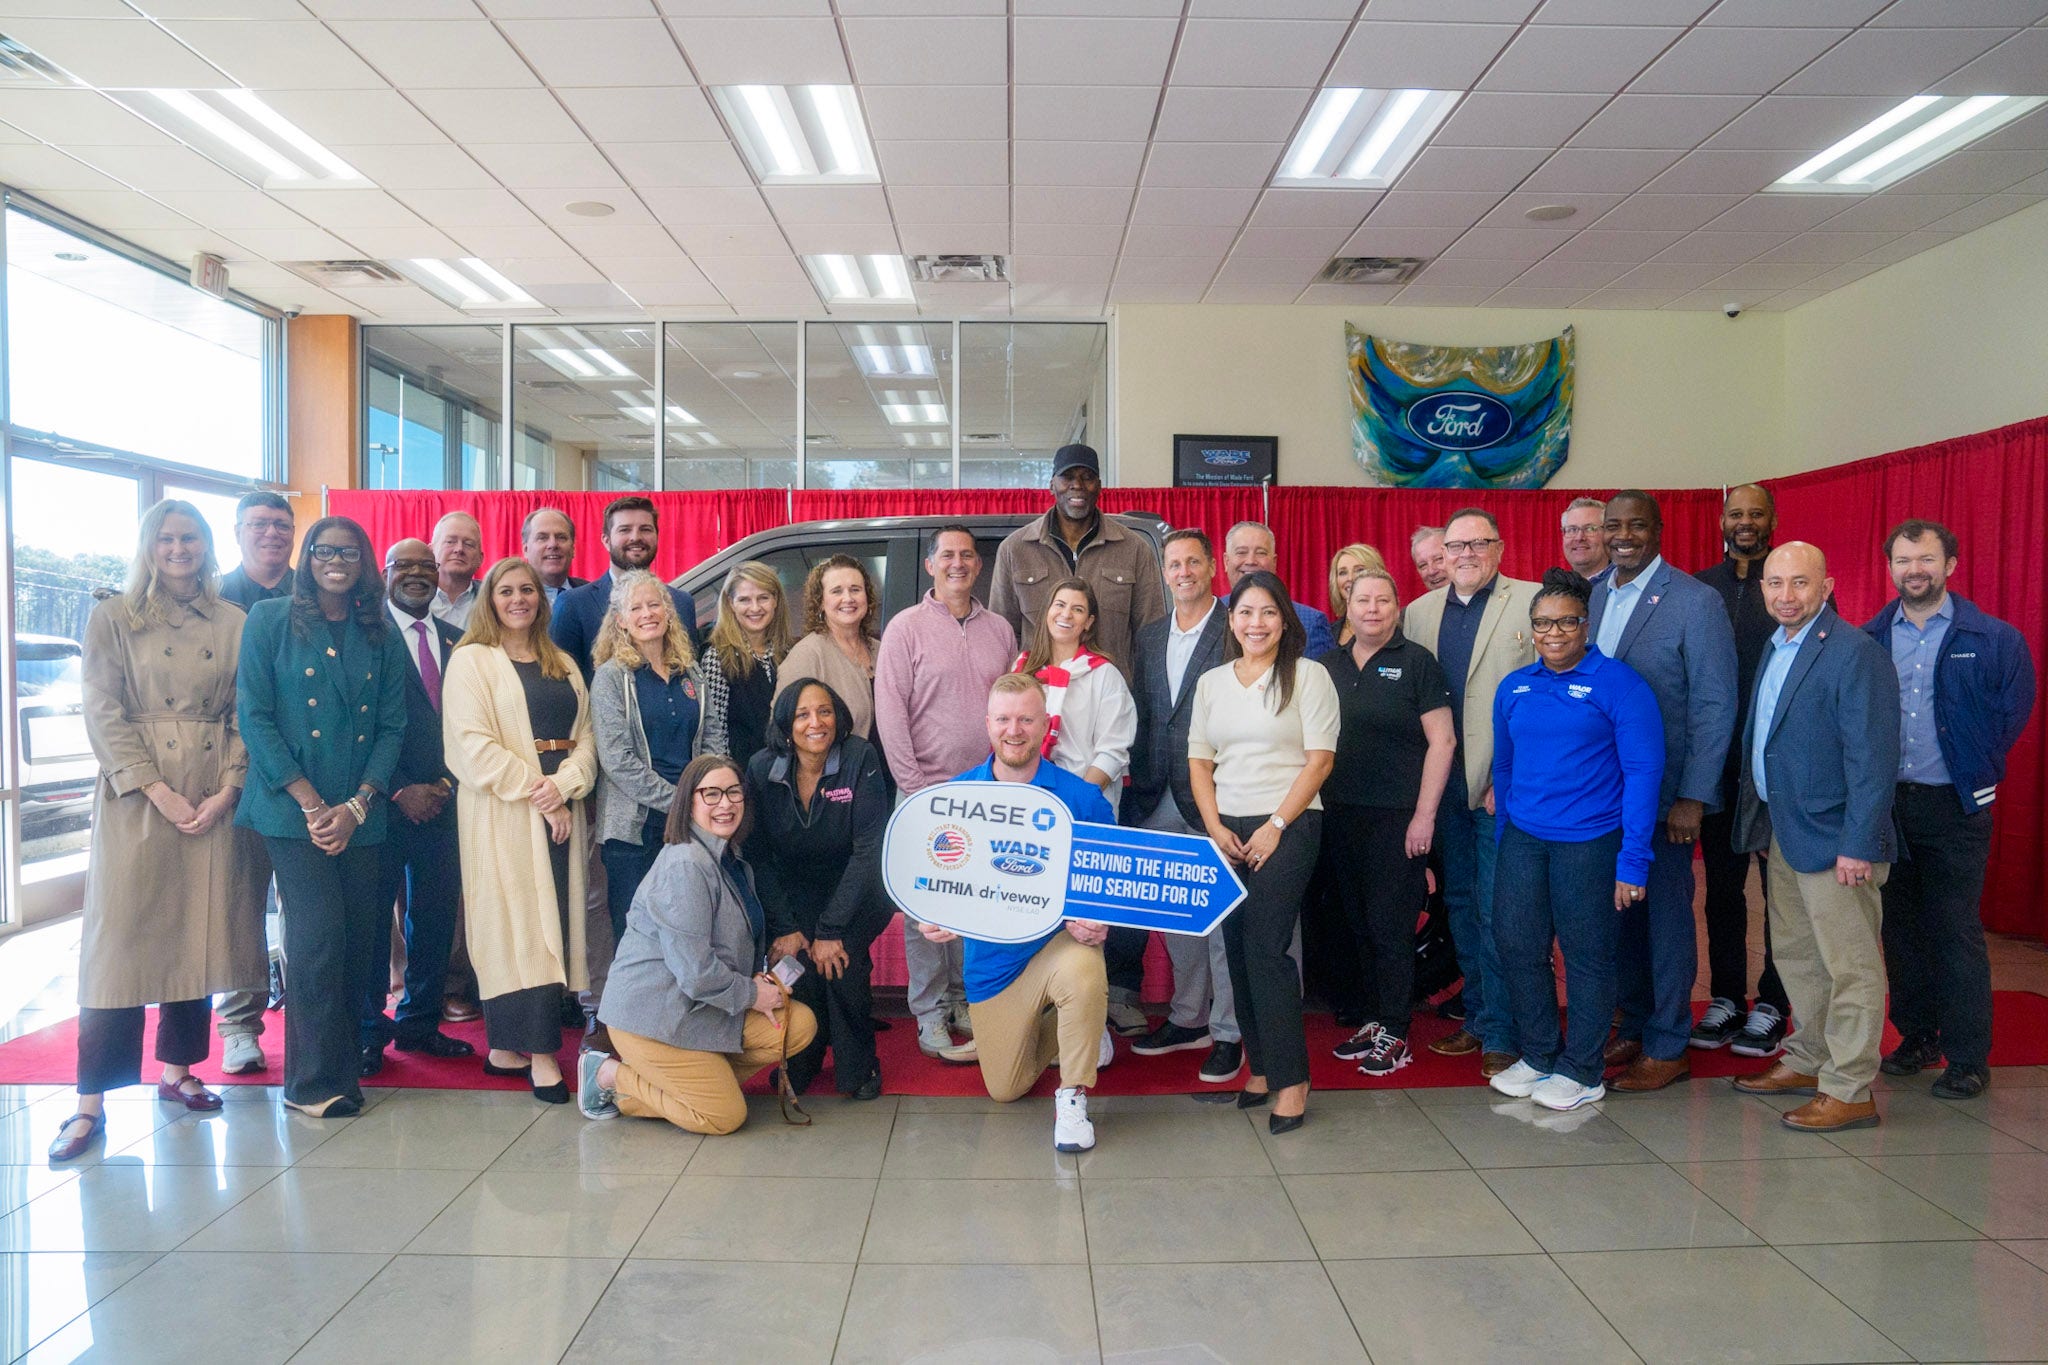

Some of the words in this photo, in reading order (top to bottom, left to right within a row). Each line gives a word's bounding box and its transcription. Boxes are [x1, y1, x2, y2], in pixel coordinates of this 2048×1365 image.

[1427, 403, 1488, 437] Ford
[1201, 449, 1251, 459] WADE
[930, 796, 1027, 826] CHASE
[990, 839, 1051, 861] WADE
[1000, 857, 1034, 873] Ford
[1073, 849, 1132, 874] SERVING
[1135, 857, 1162, 878] THE
[1163, 860, 1218, 885] HEROES
[927, 878, 973, 896] LITHIA
[979, 884, 1050, 909] driveway
[1070, 873, 1103, 894] WHO
[1105, 877, 1159, 902] SERVED
[1161, 884, 1188, 905] FOR
[1191, 888, 1210, 907] US
